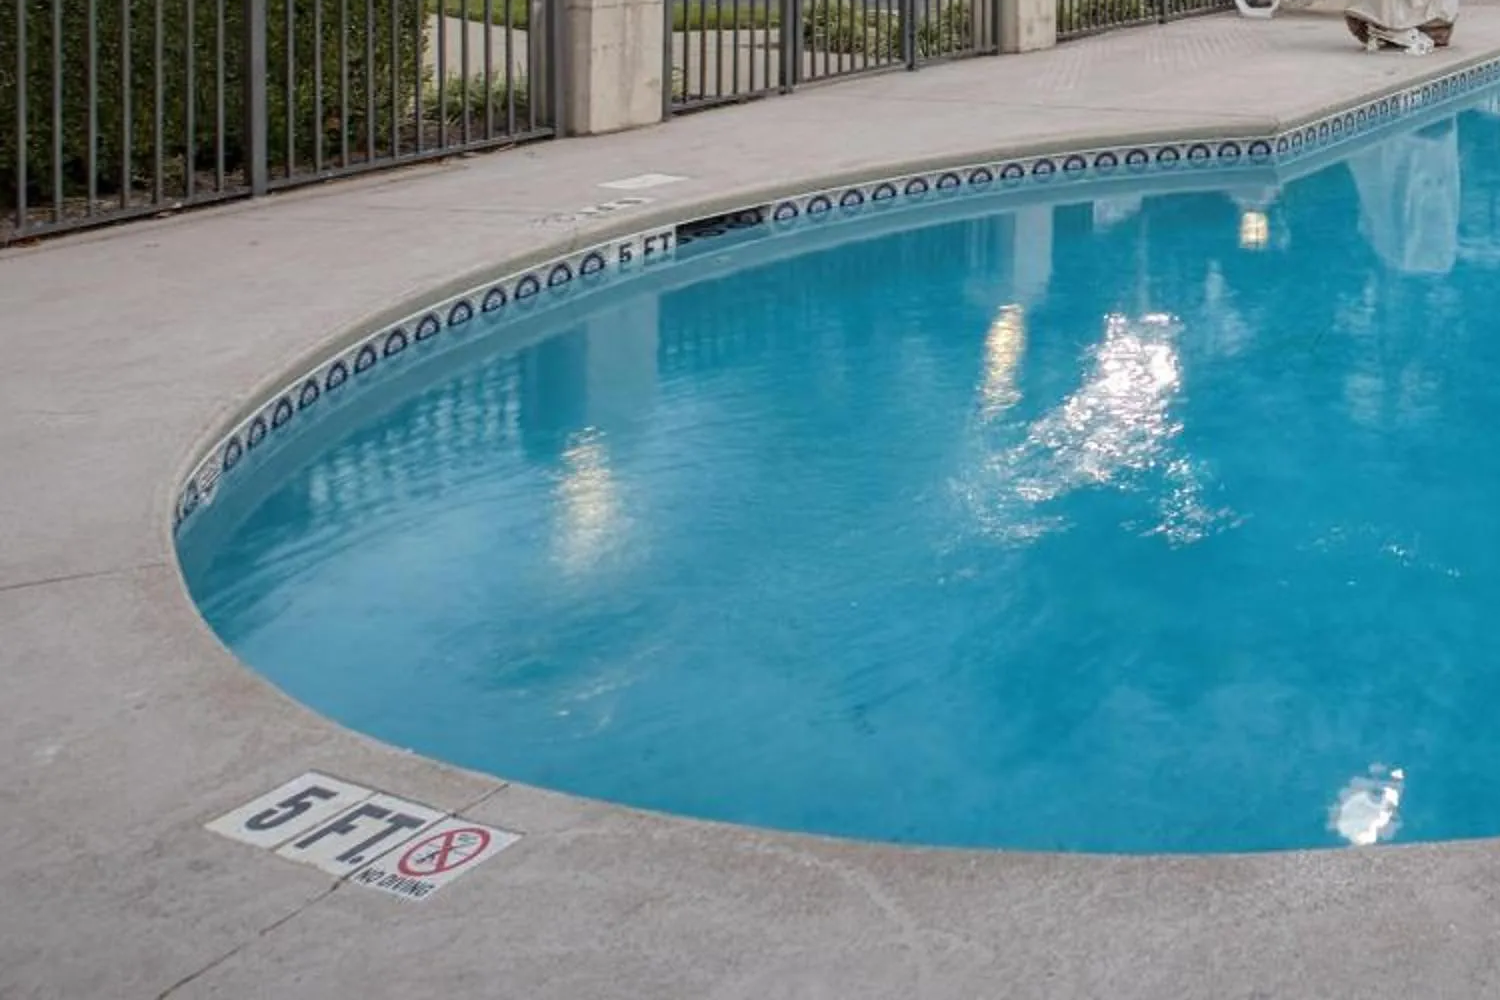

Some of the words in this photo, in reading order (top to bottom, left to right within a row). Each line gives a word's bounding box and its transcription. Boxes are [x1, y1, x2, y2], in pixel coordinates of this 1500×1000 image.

[619, 242, 632, 262] 5
[644, 231, 673, 257] FT
[244, 786, 338, 831] 5
[359, 867, 385, 884] NO
